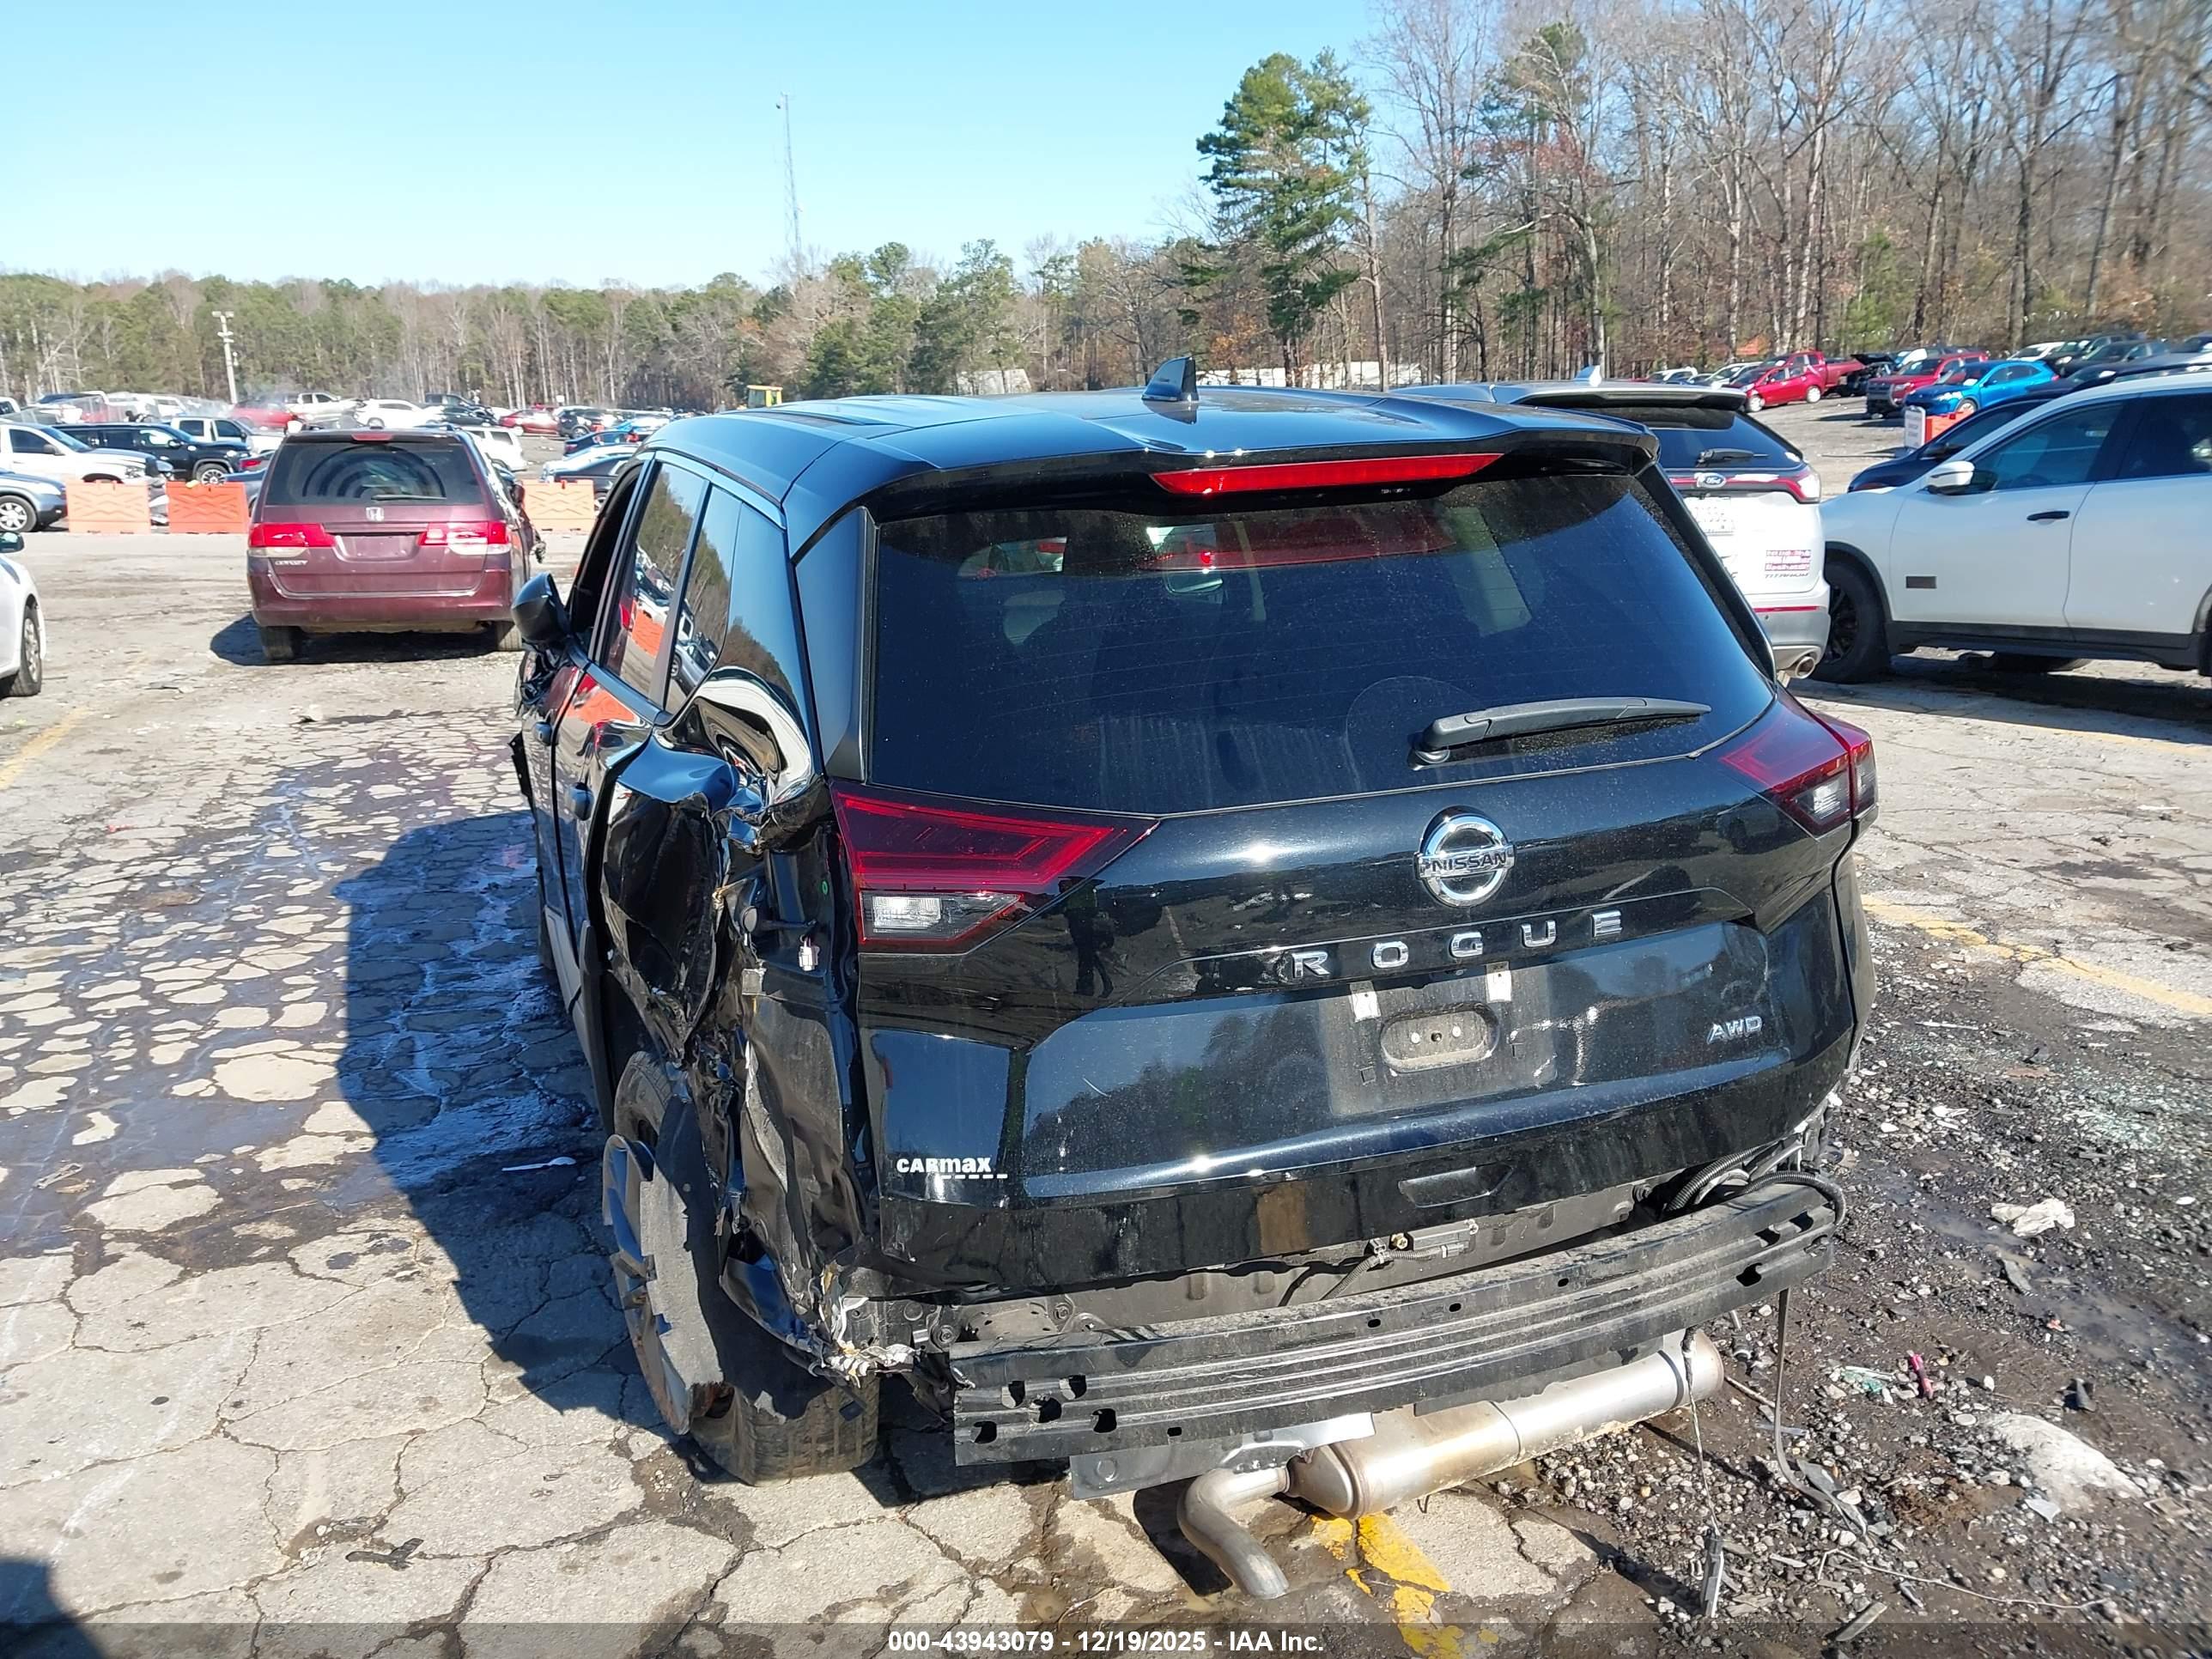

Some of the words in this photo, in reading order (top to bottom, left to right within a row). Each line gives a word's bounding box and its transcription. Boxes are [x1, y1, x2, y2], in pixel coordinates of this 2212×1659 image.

[1431, 852, 1506, 872] NISSAN
[1291, 909, 1624, 979] ROGUE
[1706, 1016, 1763, 1045] AWD
